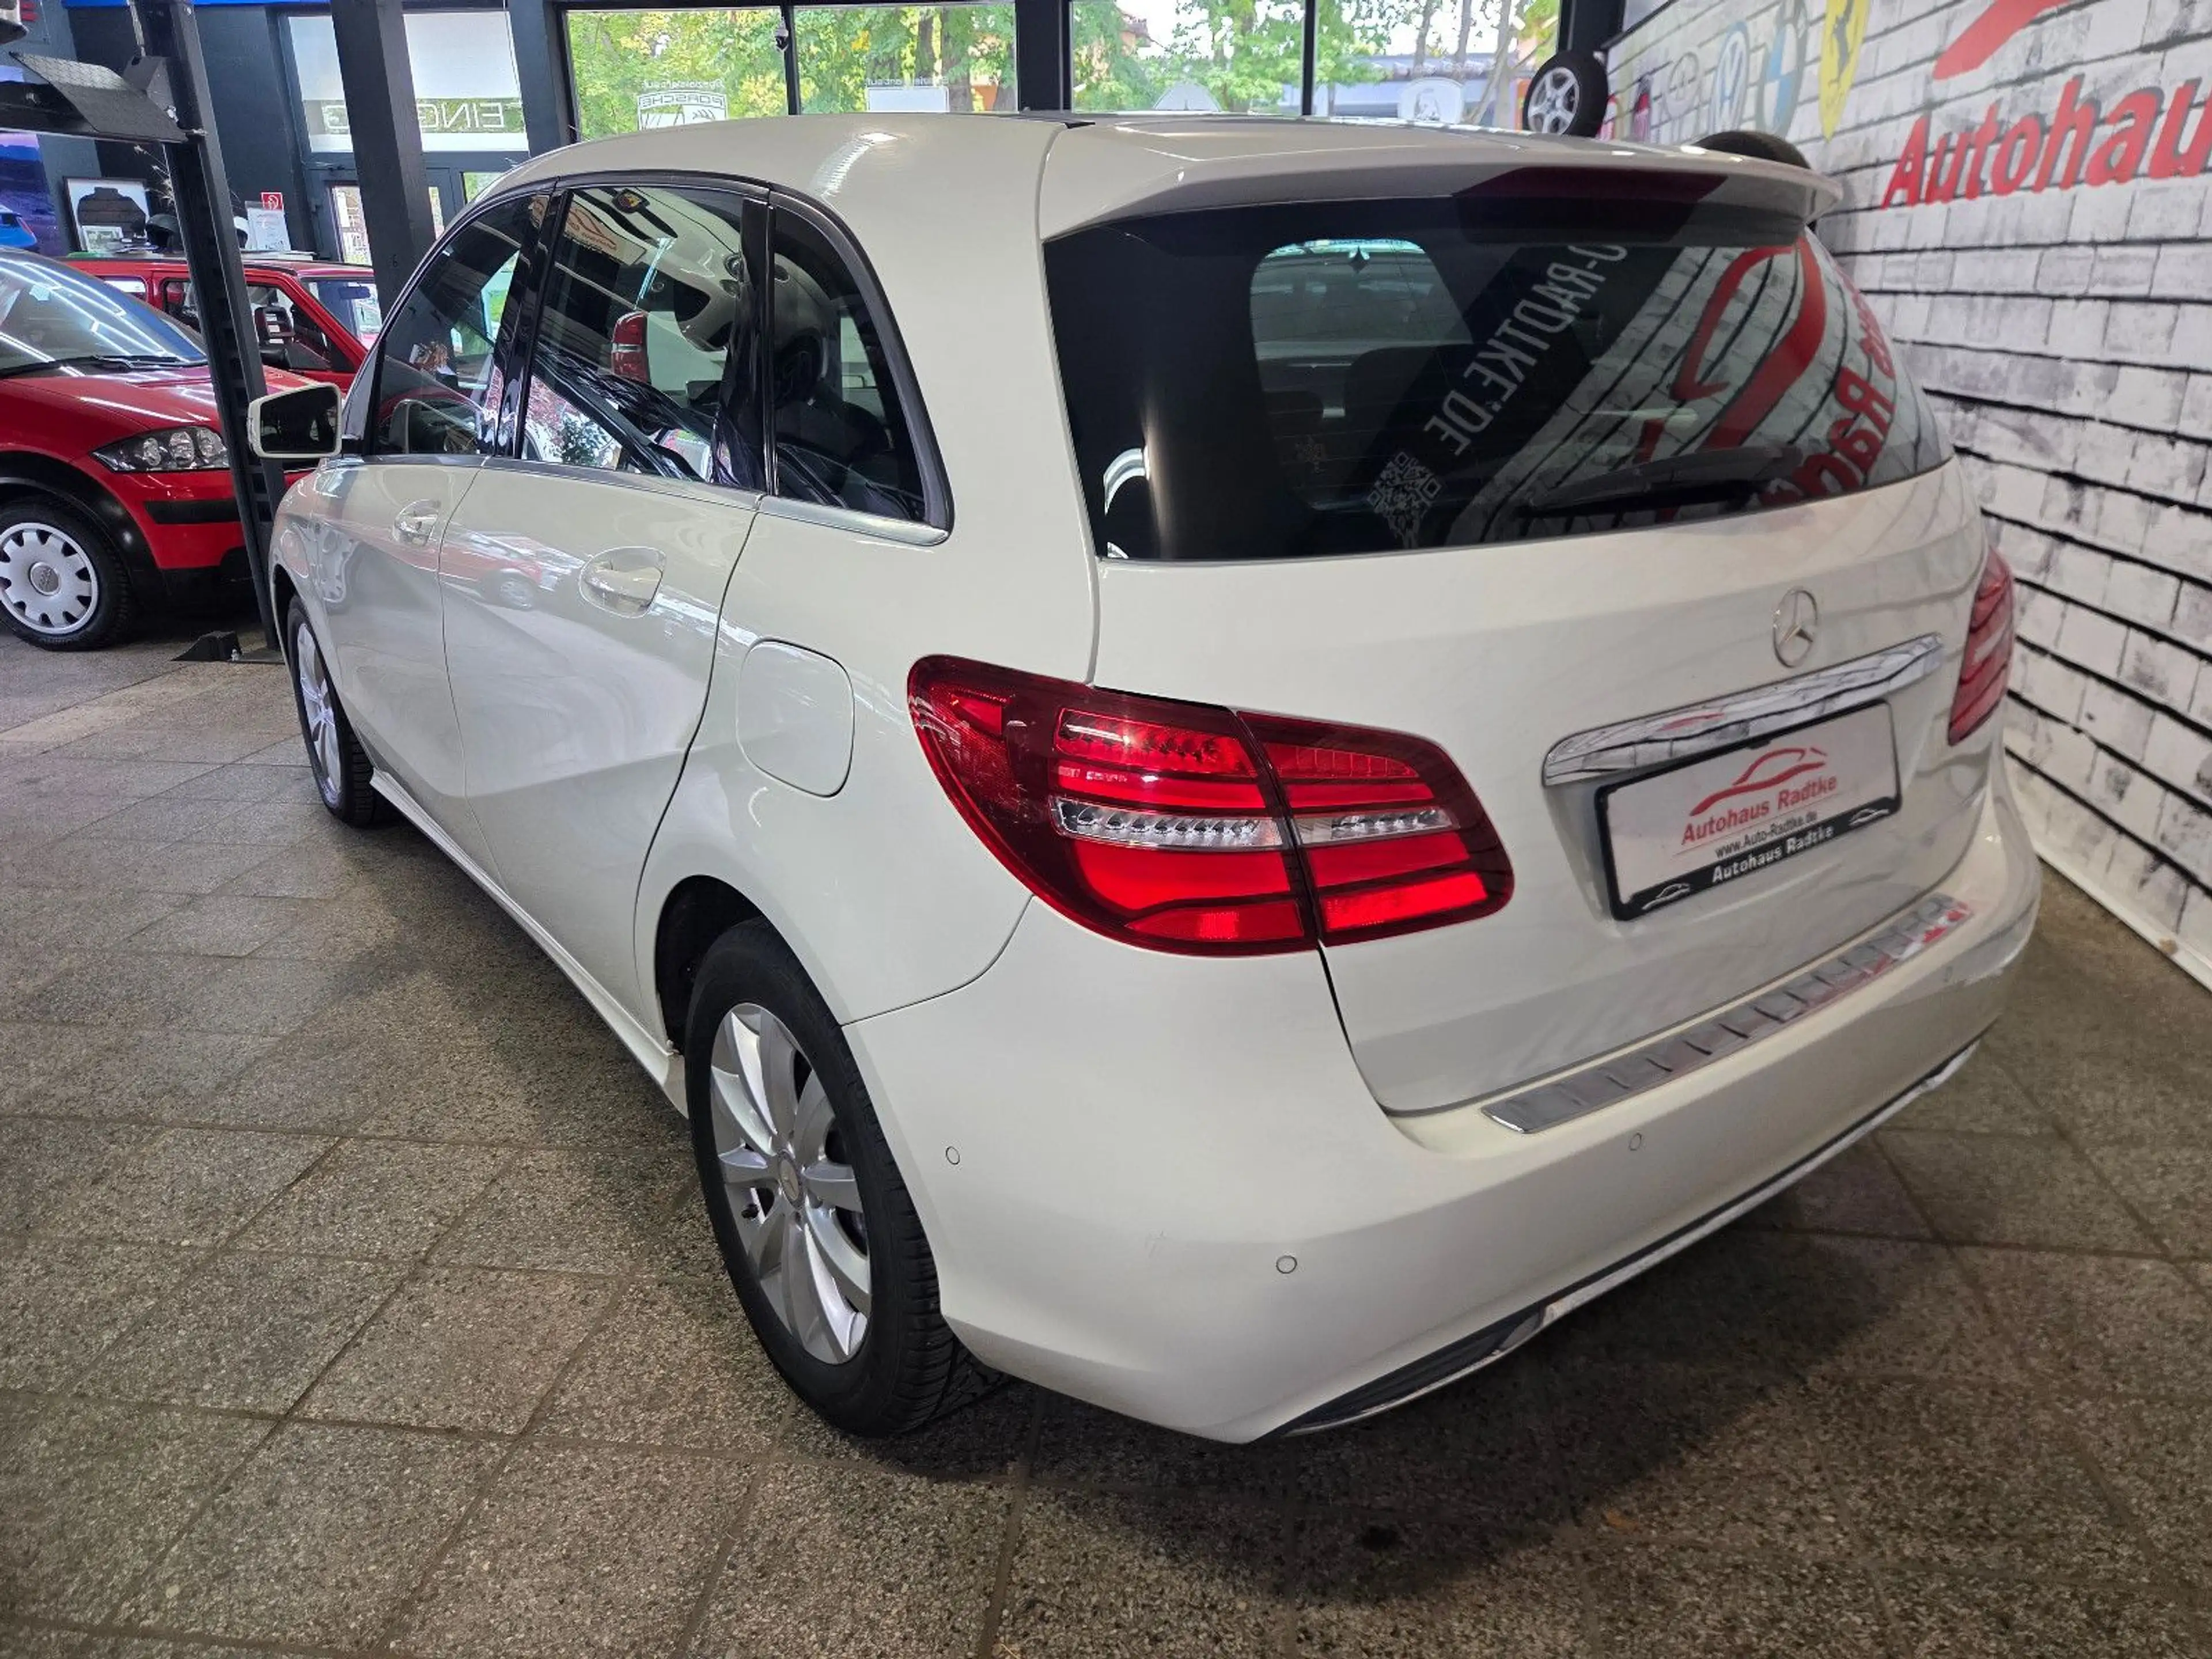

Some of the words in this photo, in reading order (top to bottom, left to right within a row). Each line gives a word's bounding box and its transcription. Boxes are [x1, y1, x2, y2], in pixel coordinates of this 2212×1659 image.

[1681, 801, 1770, 845] Autohaus
[1778, 775, 1837, 809] Radtke
[1714, 811, 1817, 858] www.Auto-Radtke.de
[1712, 846, 1783, 882] Autohaus
[1786, 825, 1834, 854] Radtke
